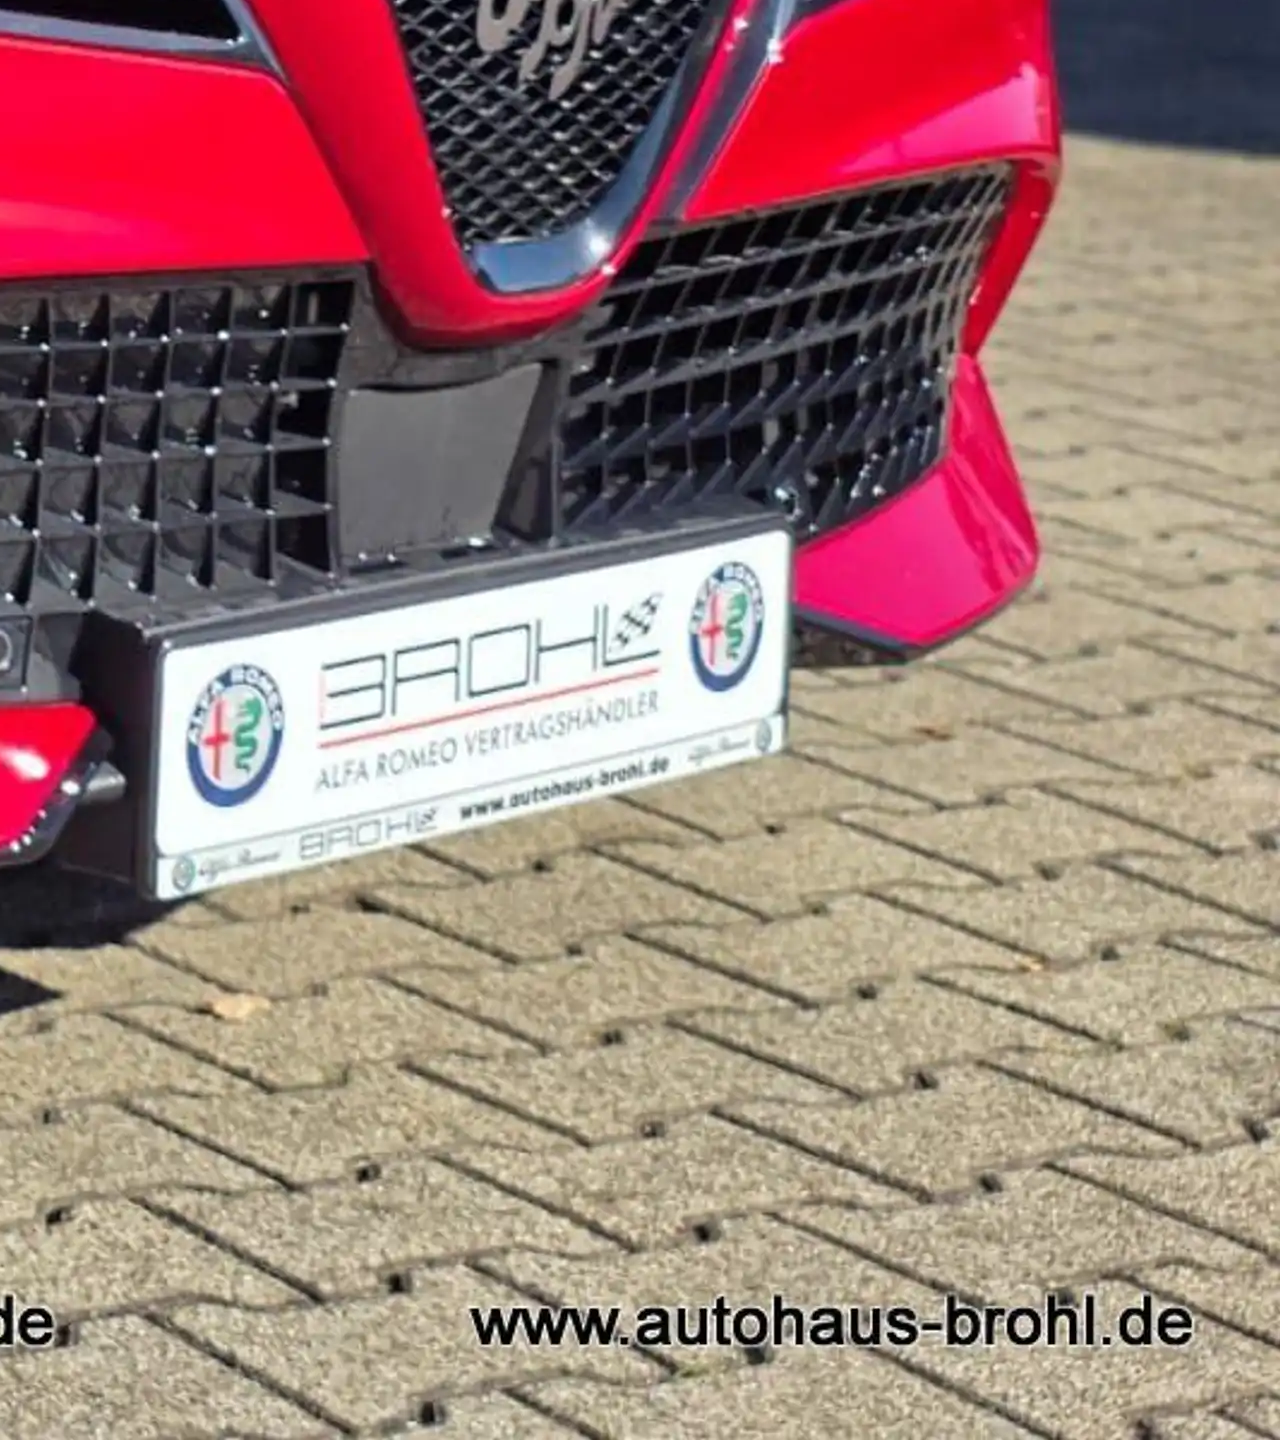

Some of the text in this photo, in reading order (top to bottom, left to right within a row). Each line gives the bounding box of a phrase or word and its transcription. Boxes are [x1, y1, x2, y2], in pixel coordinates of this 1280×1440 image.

[319, 605, 661, 730] BROHL
[314, 759, 370, 793] ALFA
[376, 736, 458, 778] ROMEO
[464, 689, 660, 757] VERTRAGSHÄNDLER
[459, 756, 671, 820] www.autohaus-brohl.de
[299, 809, 438, 860] BROHL
